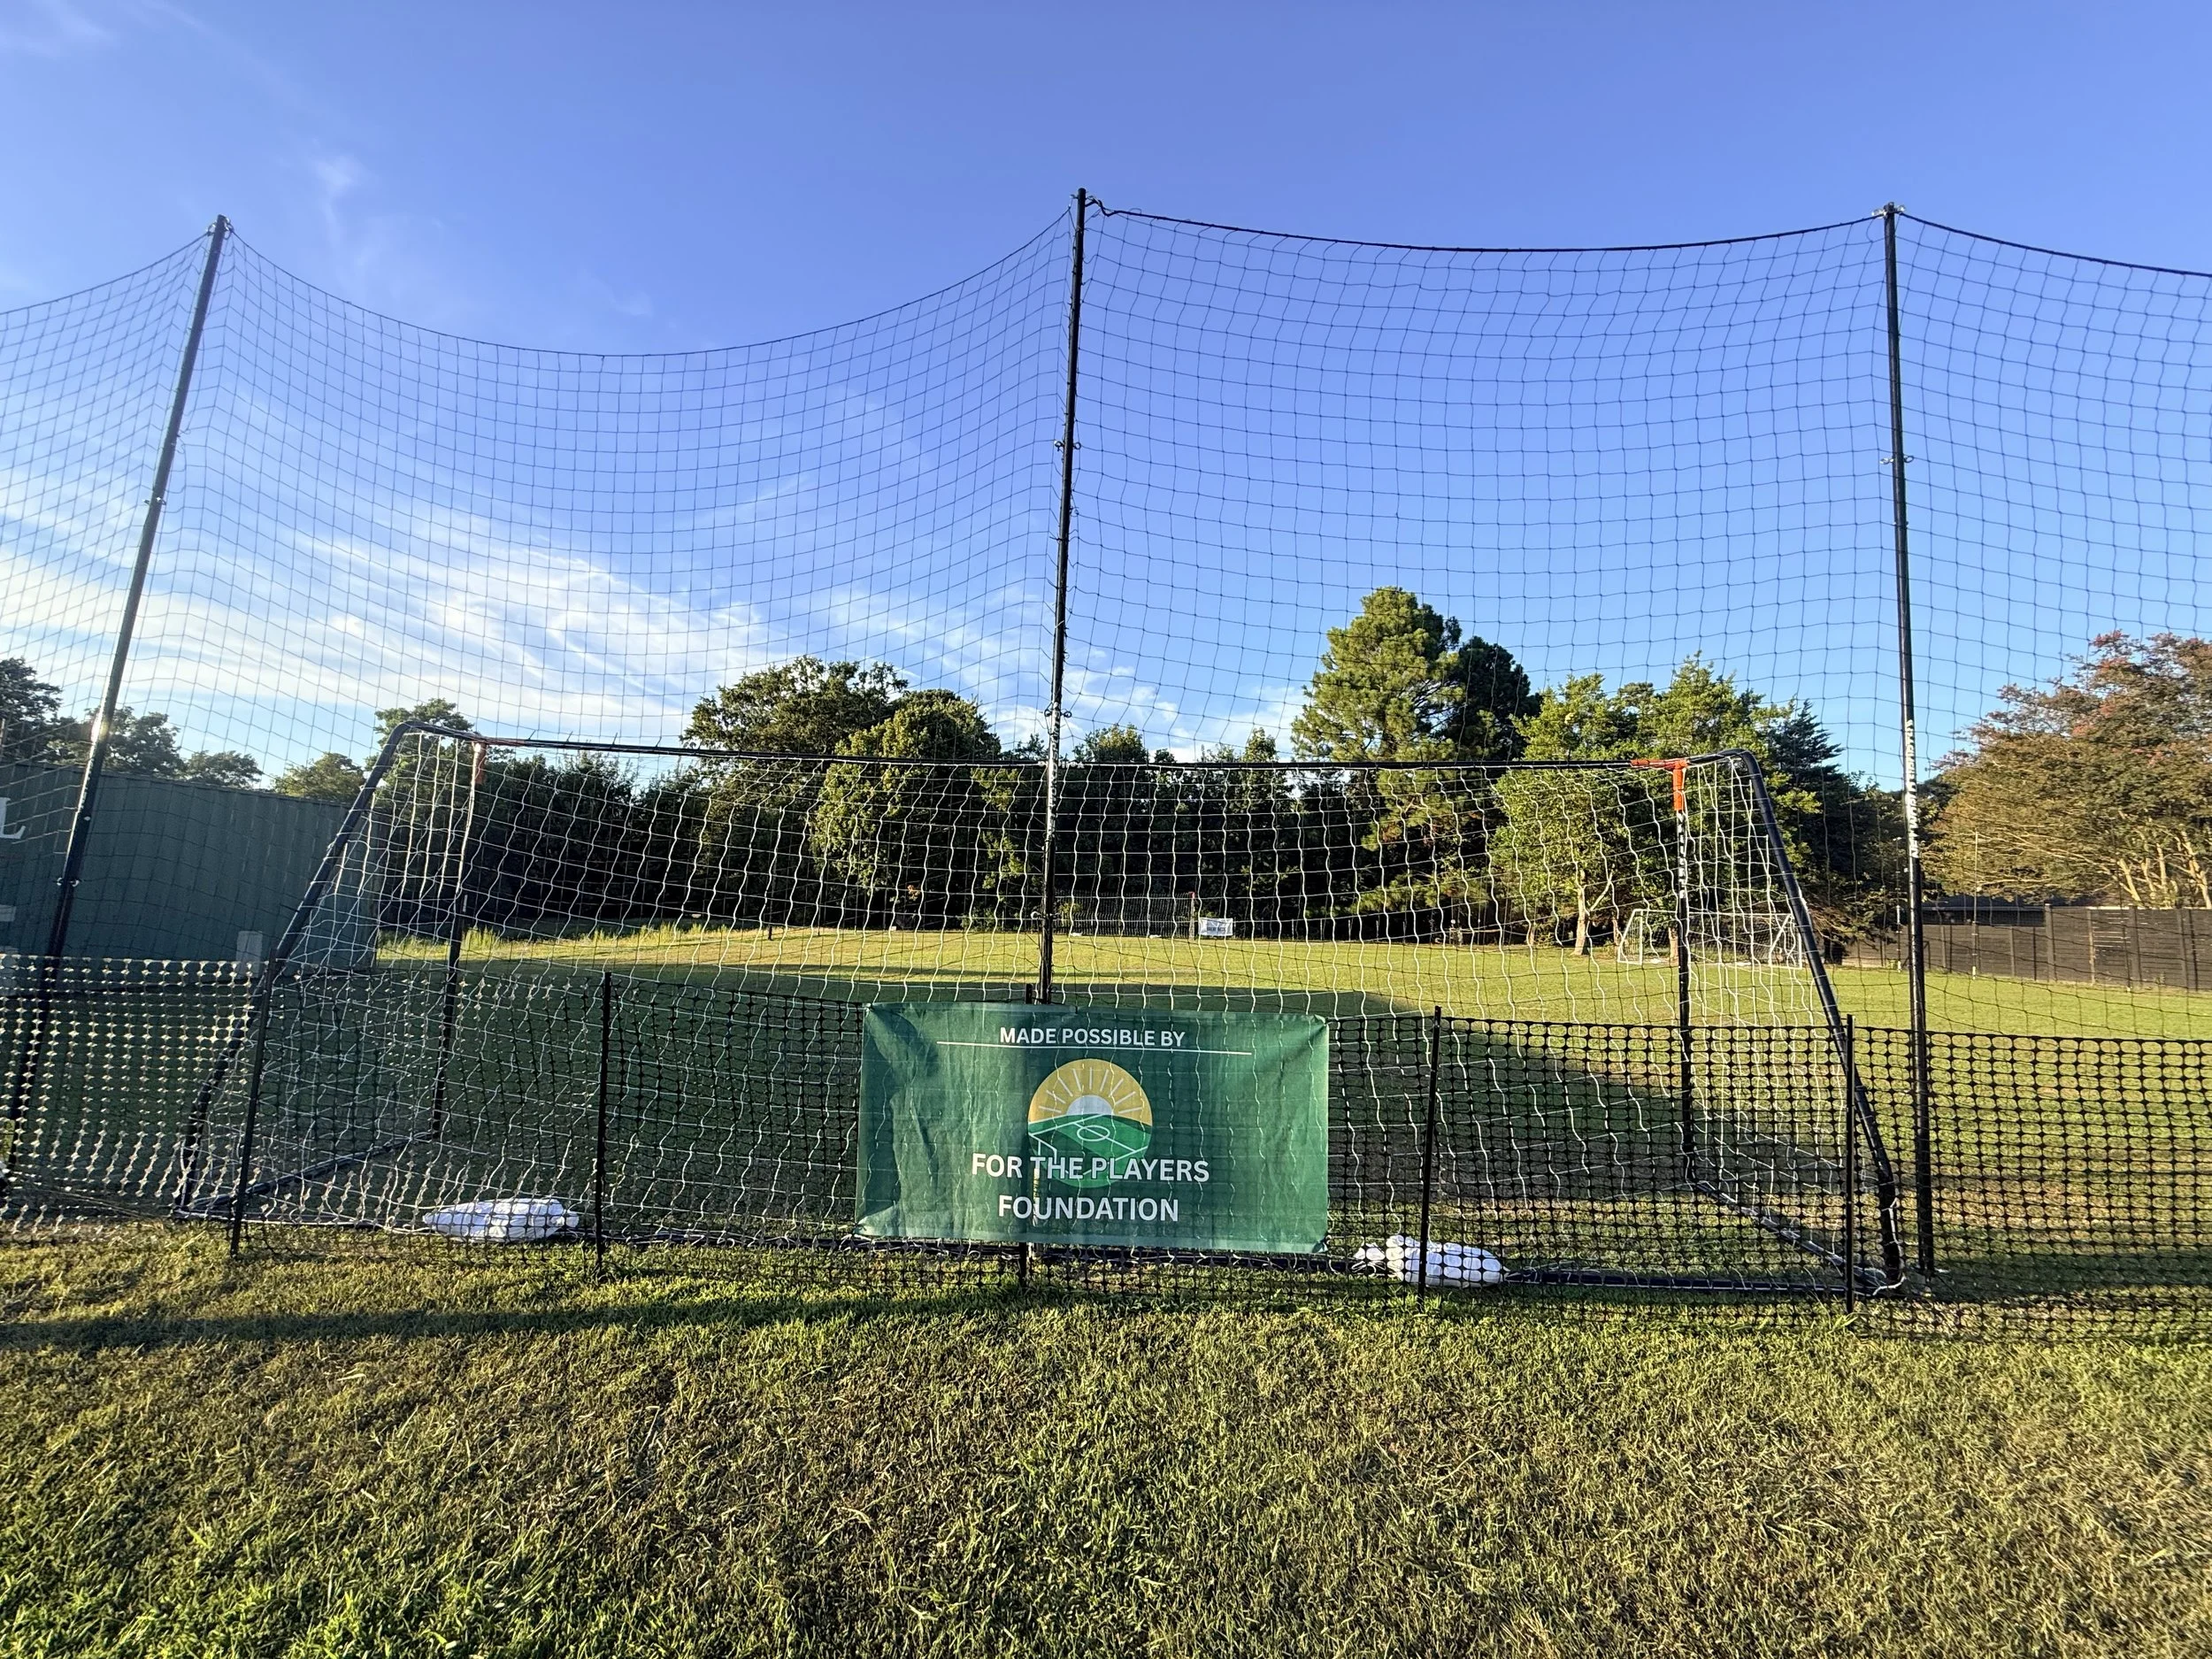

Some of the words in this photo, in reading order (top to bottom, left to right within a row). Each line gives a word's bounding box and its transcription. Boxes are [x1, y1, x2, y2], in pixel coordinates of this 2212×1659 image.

[1000, 1027, 1056, 1044] MADE
[1062, 1028, 1155, 1047] POSSIBLE
[1161, 1031, 1186, 1047] BY
[972, 1153, 1023, 1178] FOR
[1030, 1156, 1084, 1179] THE
[1091, 1157, 1210, 1182] PLAYERS
[998, 1194, 1179, 1222] FOUNDATION
